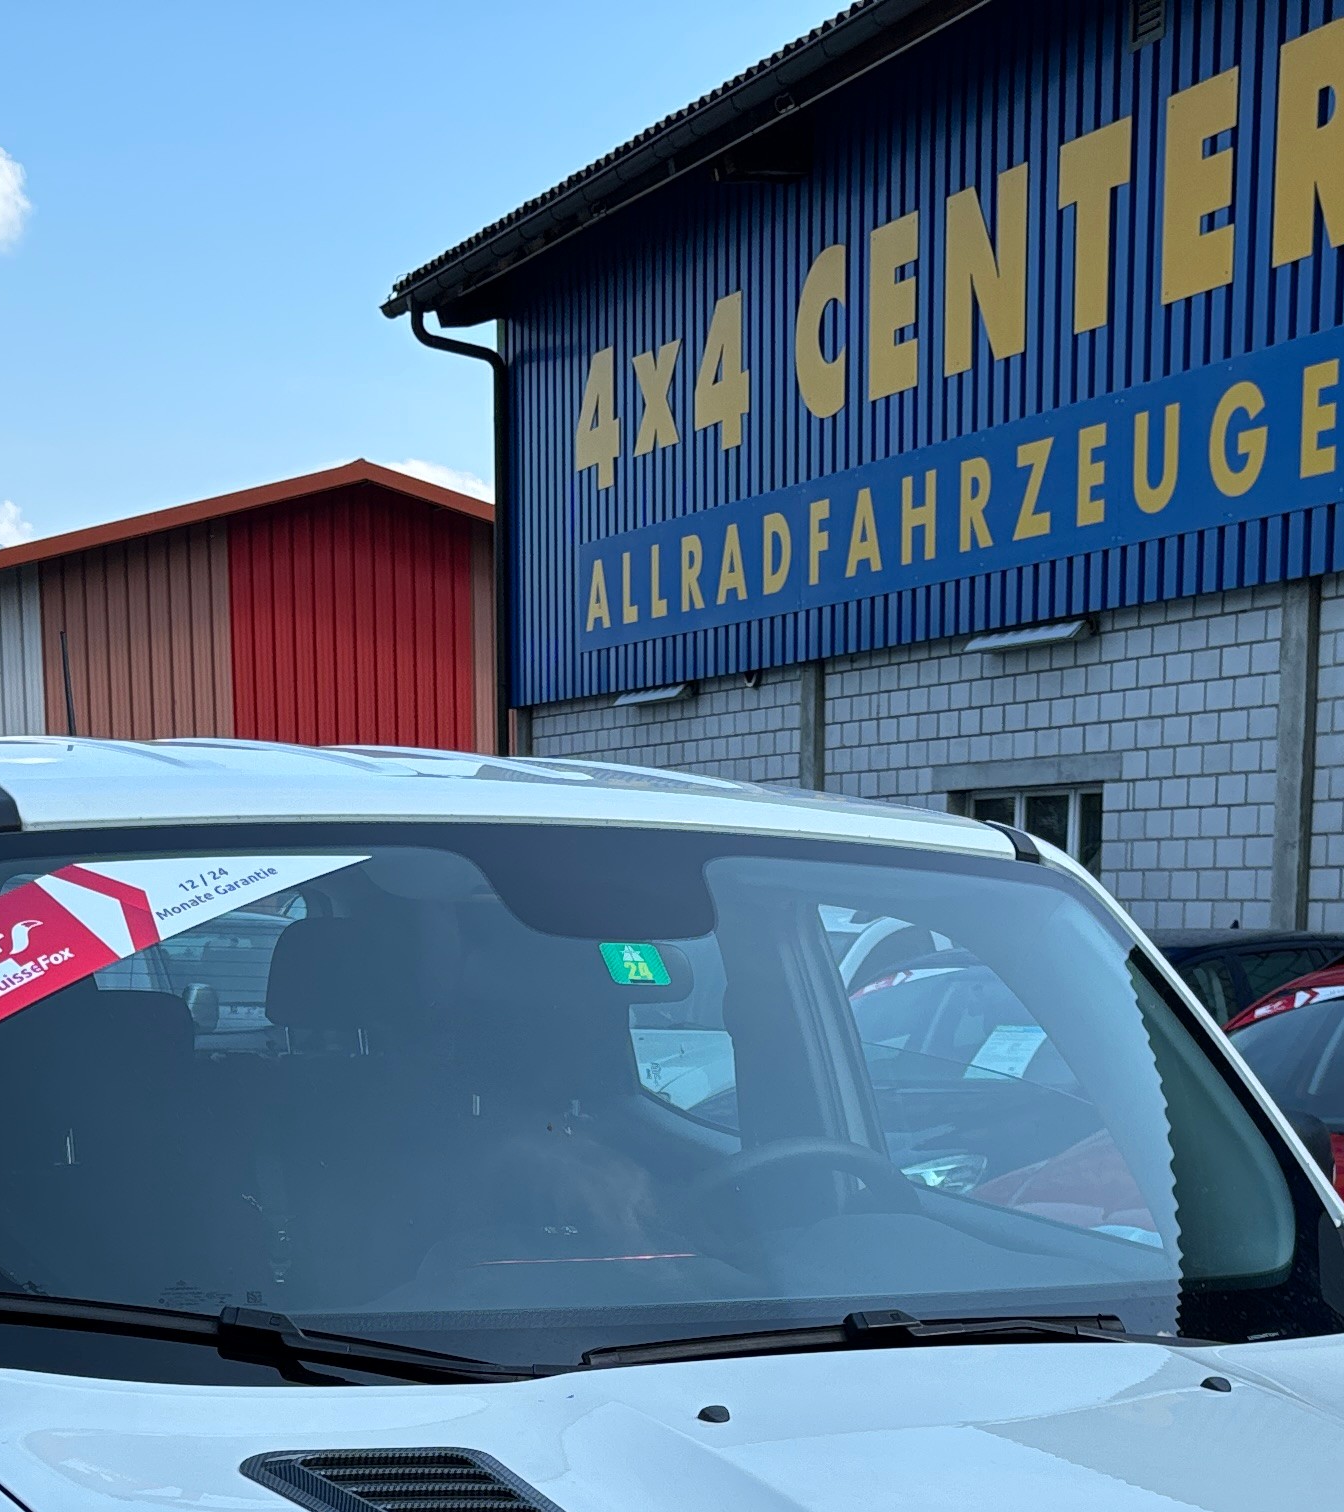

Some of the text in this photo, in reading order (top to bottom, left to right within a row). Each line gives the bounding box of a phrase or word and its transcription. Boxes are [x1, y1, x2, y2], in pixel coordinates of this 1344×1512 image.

[574, 290, 750, 490] 4x4
[585, 358, 1340, 633] ALLRADFAHRZEUGE
[156, 867, 278, 920] Monate Garantie
[178, 867, 229, 892] 12 / 24
[623, 961, 654, 981] 24
